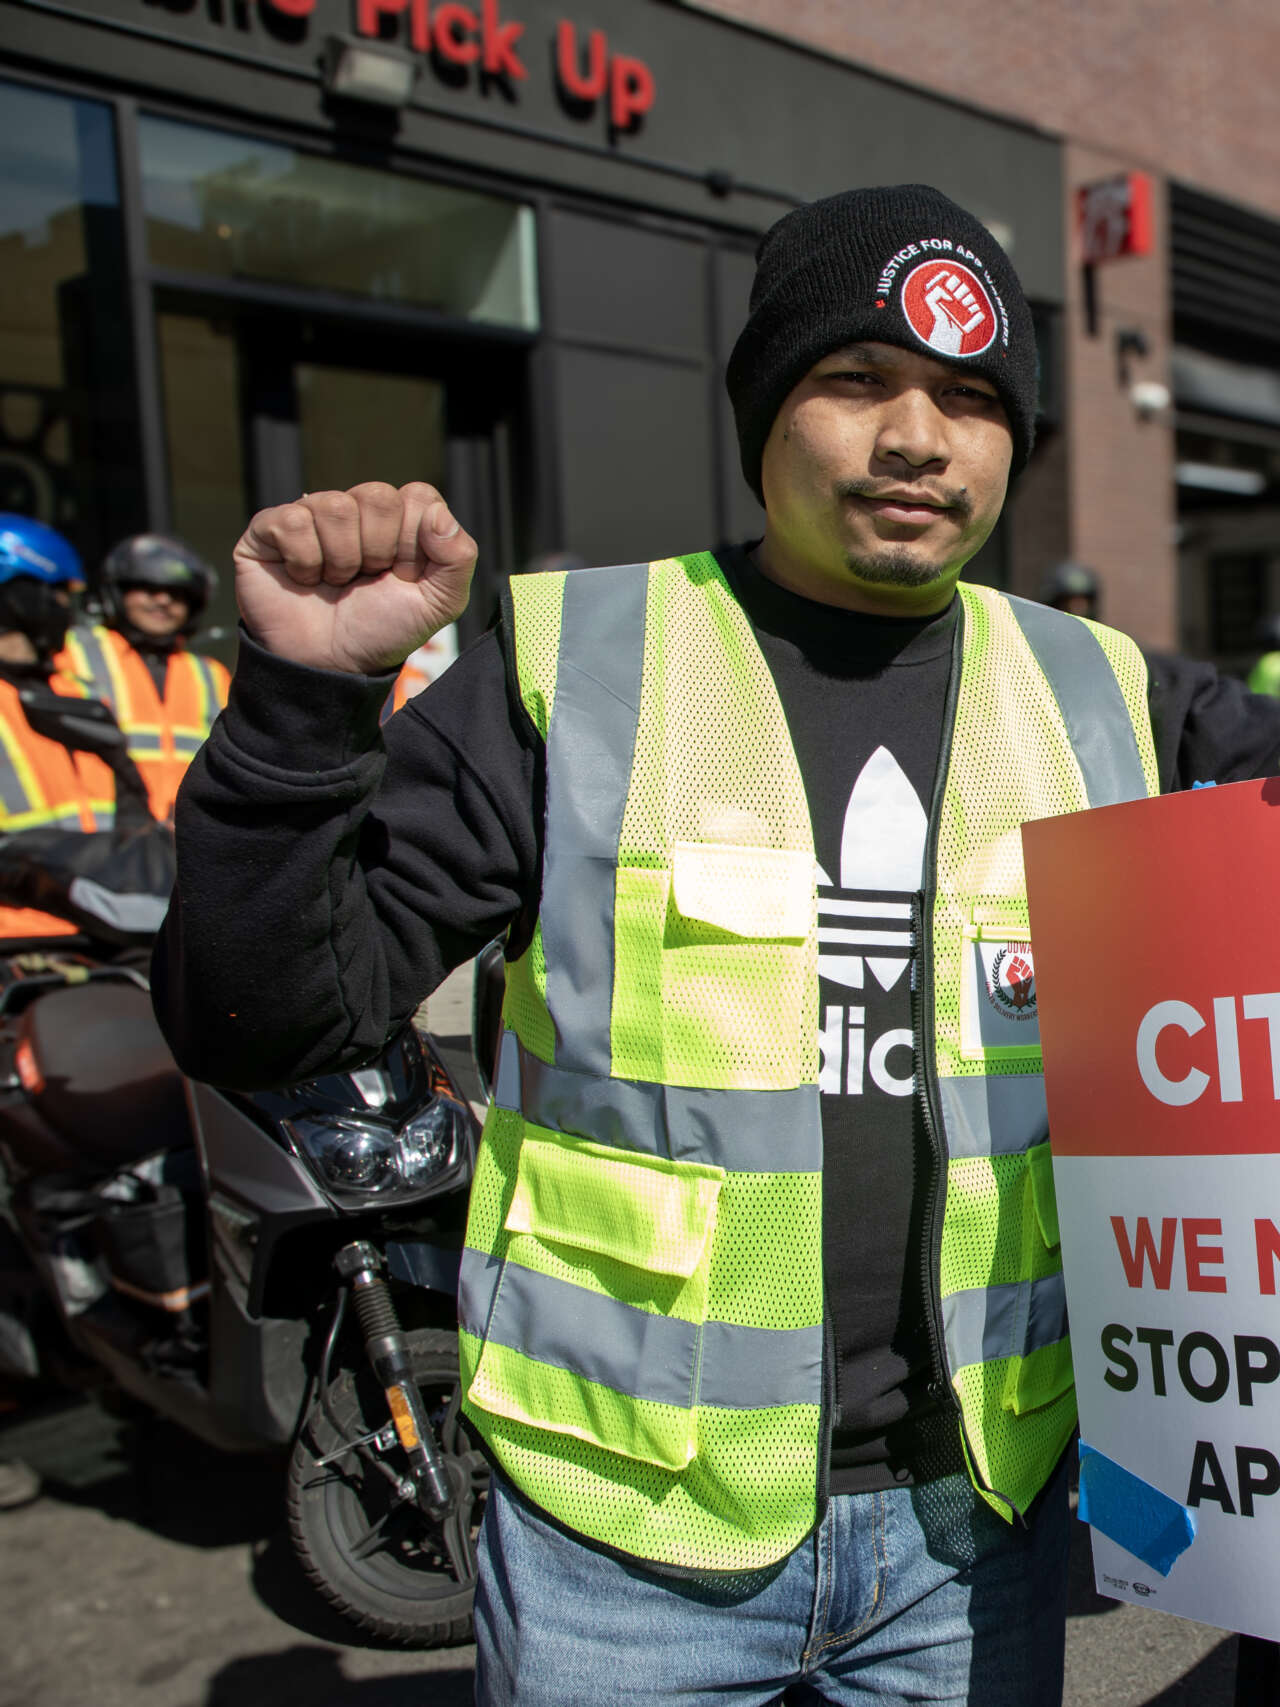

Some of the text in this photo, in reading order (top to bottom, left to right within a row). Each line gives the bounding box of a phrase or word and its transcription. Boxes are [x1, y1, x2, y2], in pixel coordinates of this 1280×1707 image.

[556, 18, 656, 128] Up
[876, 243, 921, 297] JUSTICE
[920, 237, 953, 252] FOR
[956, 244, 983, 268] APP
[1110, 1216, 1228, 1294] WE
